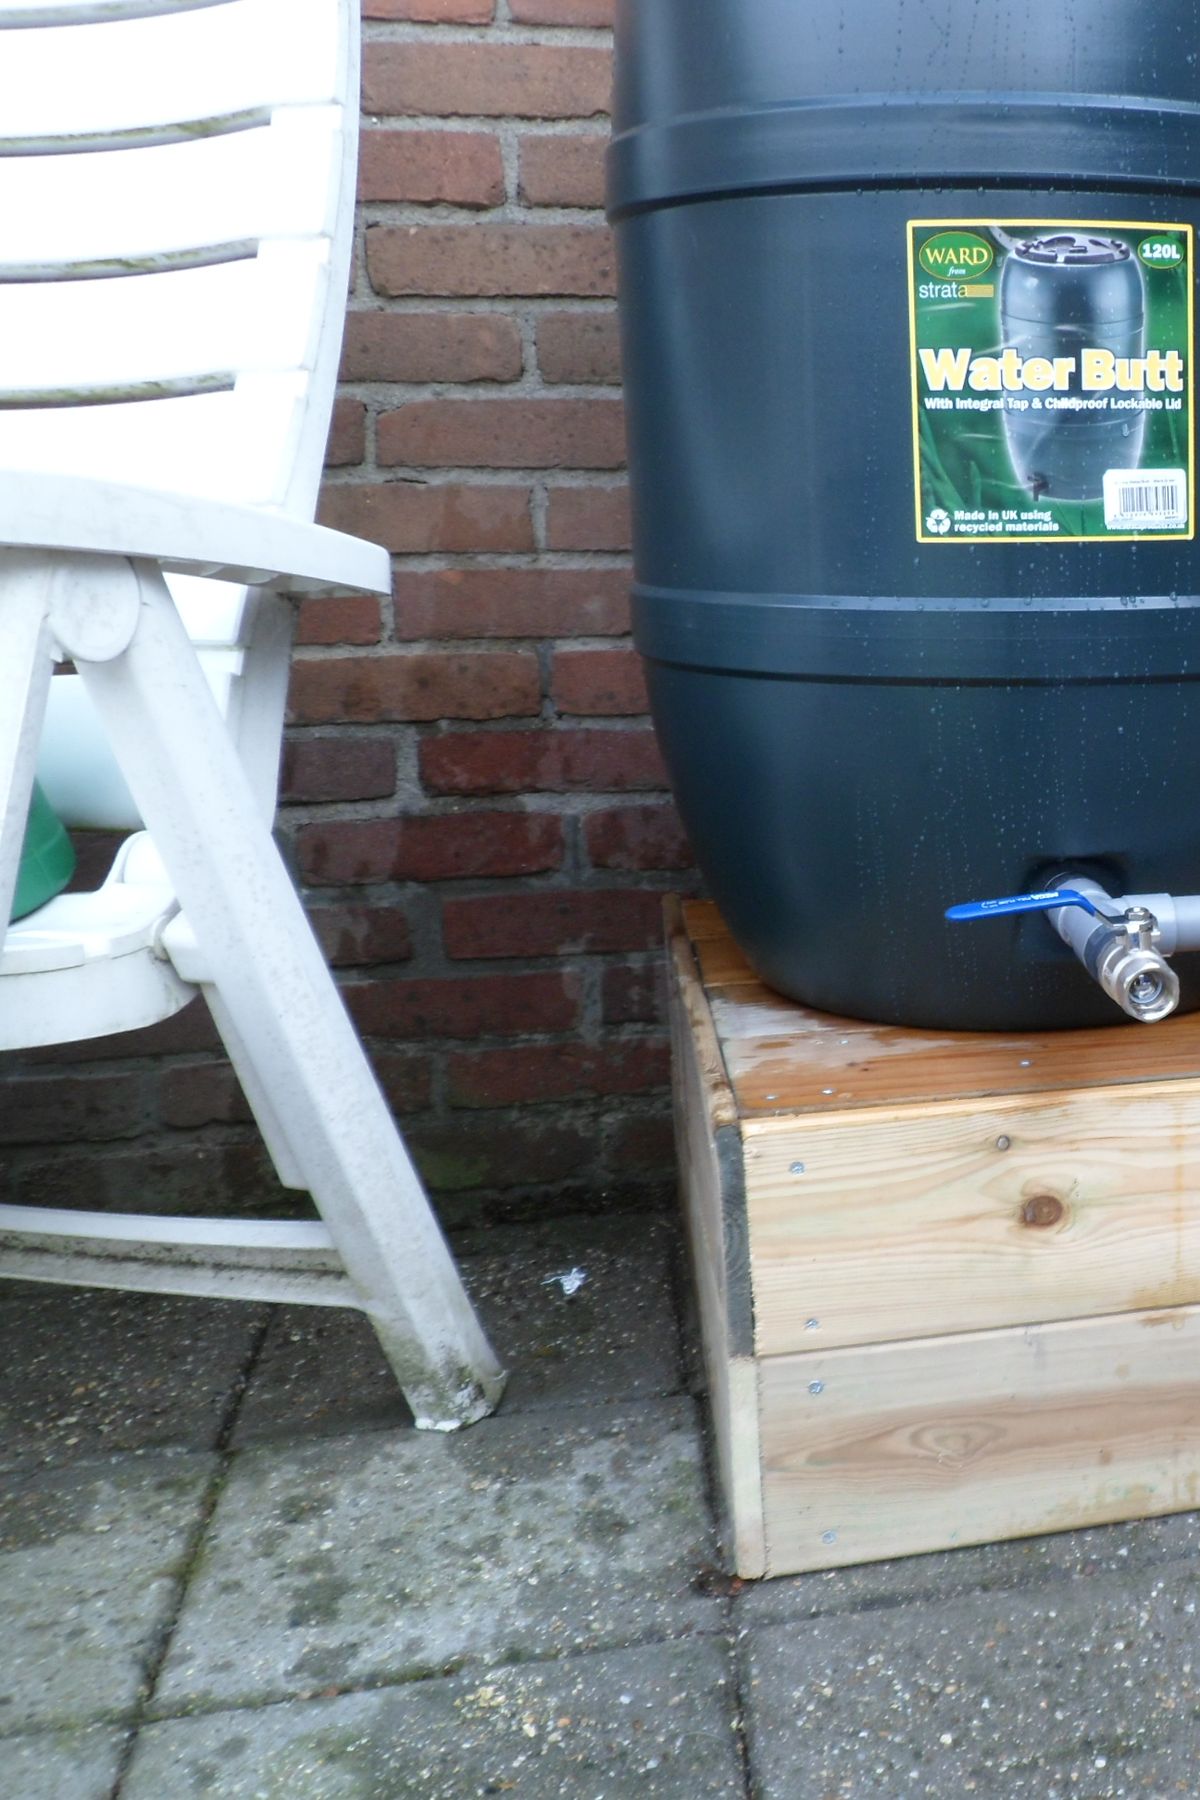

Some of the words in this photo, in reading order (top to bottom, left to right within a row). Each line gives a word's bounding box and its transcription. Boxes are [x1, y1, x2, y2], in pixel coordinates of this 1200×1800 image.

[925, 246, 989, 265] WARD
[1141, 243, 1181, 259] 120L
[947, 267, 967, 277] from
[918, 283, 968, 298] strata
[918, 348, 1076, 392] Water
[1080, 348, 1184, 392] Butt
[924, 397, 953, 409] With
[955, 397, 1004, 411] Integral
[1007, 398, 1029, 411] Tap
[1031, 398, 1043, 410] &
[1044, 397, 1109, 410] Childproof
[1111, 397, 1163, 410] Lockable
[1165, 397, 1182, 410] Lid
[954, 510, 985, 521] Made
[1001, 510, 1018, 520] UK
[1020, 510, 1052, 523] using
[954, 522, 1003, 534] recycled
[1005, 521, 1060, 532] materials
